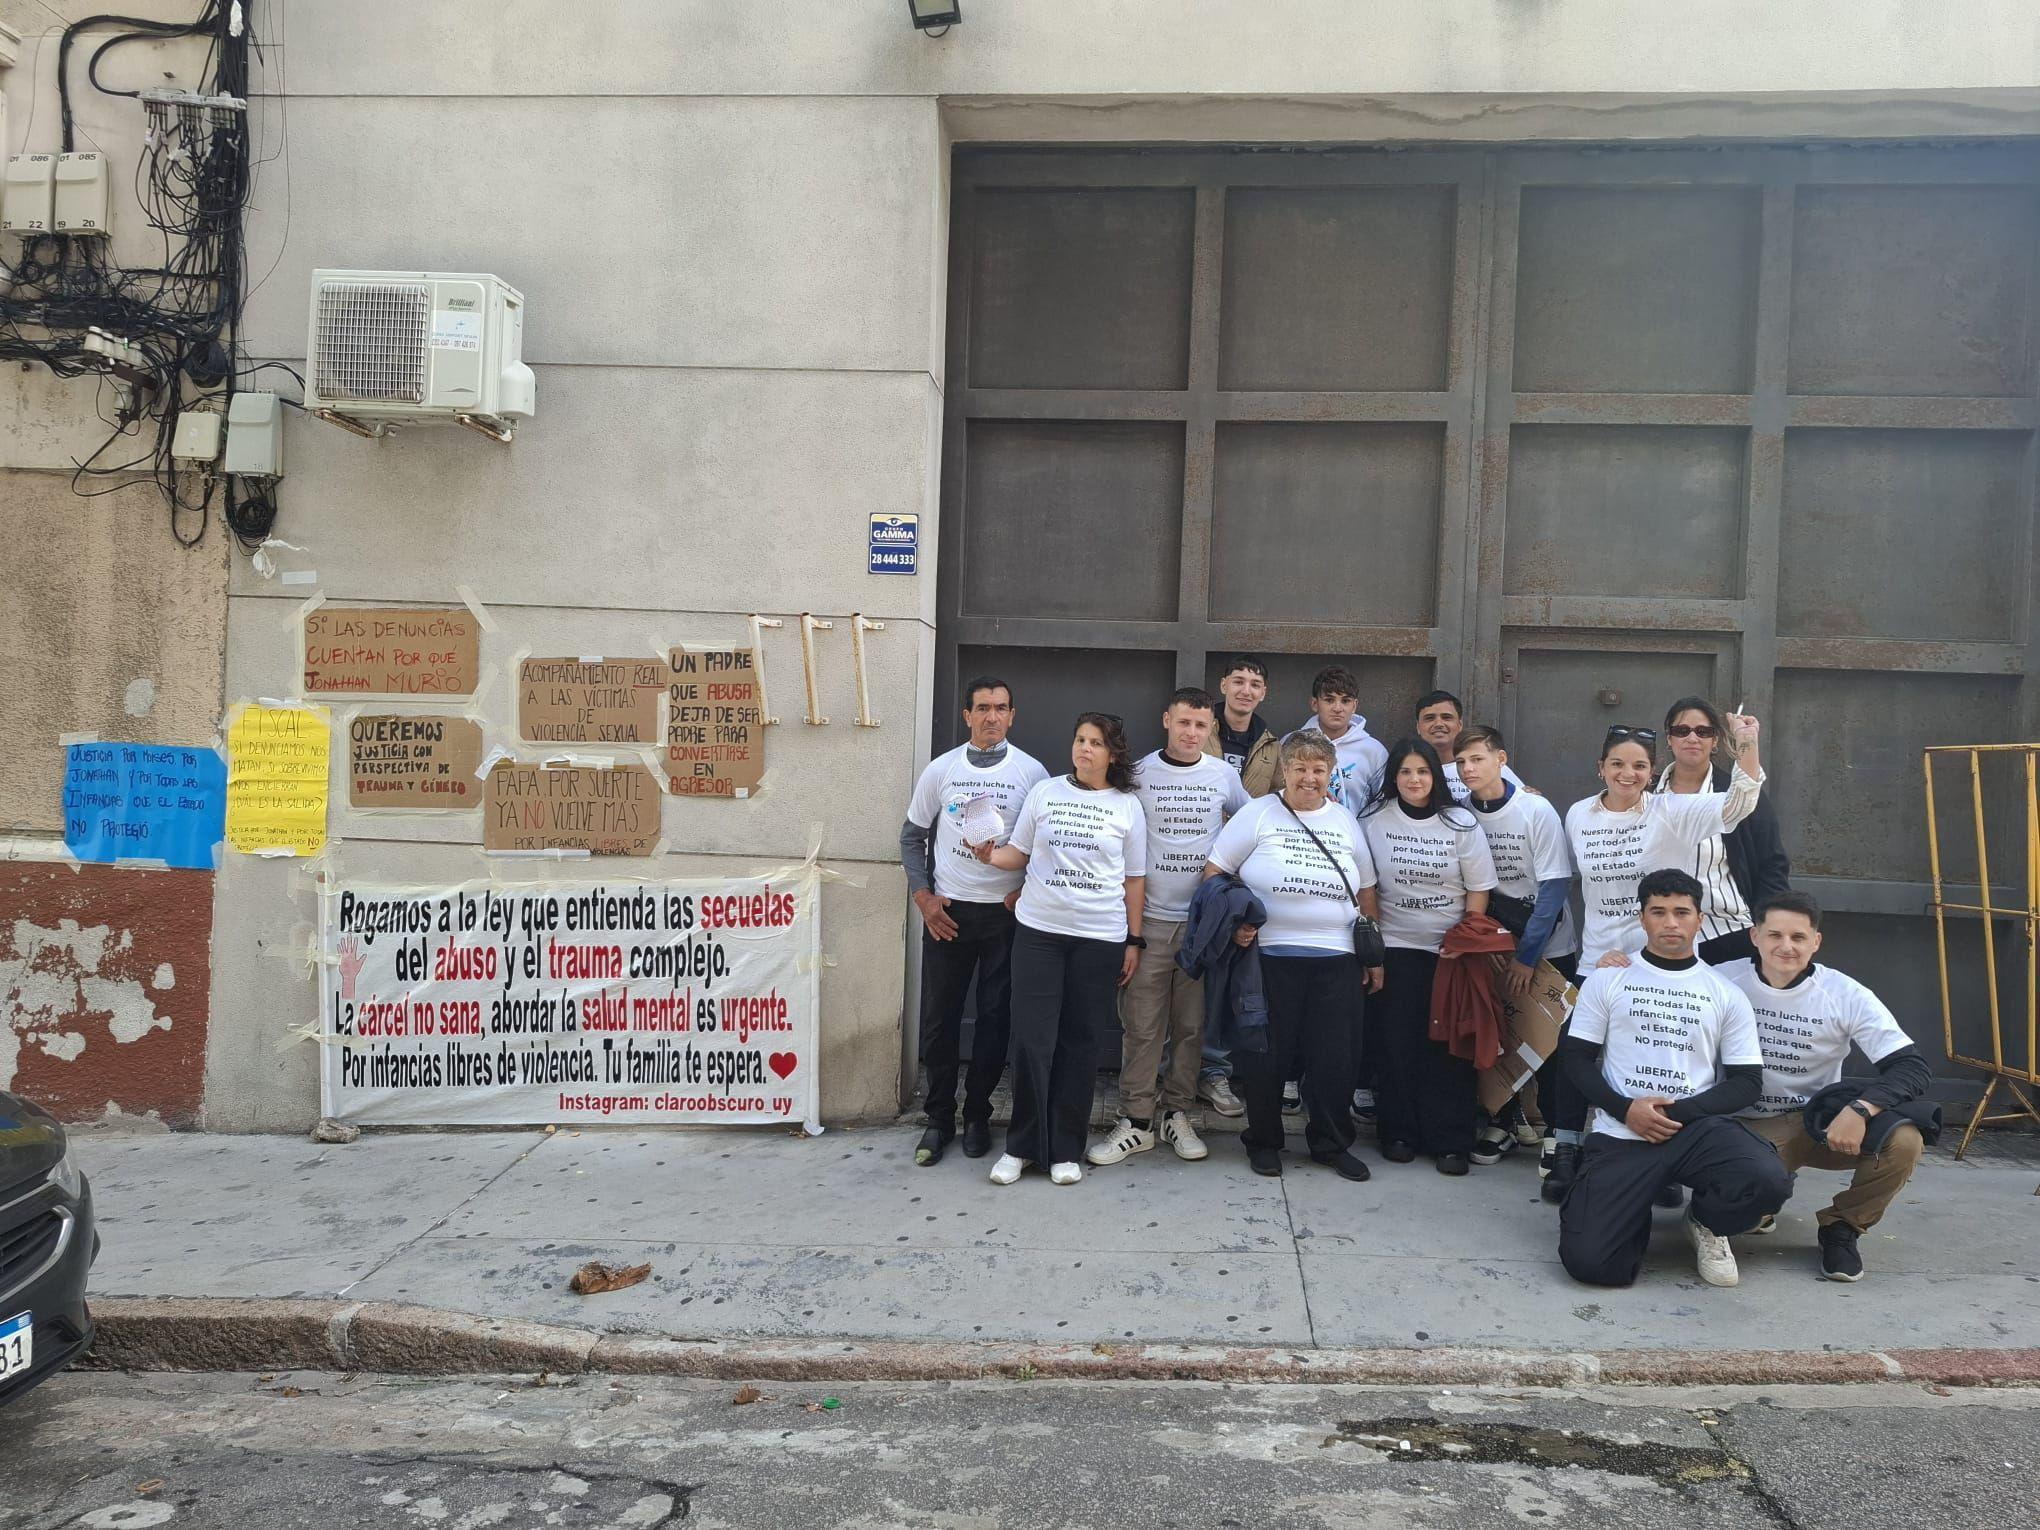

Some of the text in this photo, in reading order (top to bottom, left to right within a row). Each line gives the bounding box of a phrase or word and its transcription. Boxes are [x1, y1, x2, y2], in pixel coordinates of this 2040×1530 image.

[83, 220, 95, 228] 20
[873, 530, 914, 539] GAMMA
[872, 554, 914, 564] 28 444 333
[335, 621, 366, 637] LAS
[393, 650, 422, 666] POR
[672, 652, 752, 673] UN PADRE
[522, 663, 665, 686] ACOMPAÑAMIENTO REAL
[528, 686, 636, 708] A LAS VÍCTIMAS
[670, 683, 752, 702] QUE ABUSA
[578, 708, 594, 724] DE
[670, 705, 760, 724] DEJA DE SER
[352, 721, 444, 742] QUEREMOS
[532, 724, 640, 742] VIOLENCIA SEXUAL
[668, 726, 748, 744] PADRE PARA
[414, 746, 432, 758] CON
[670, 744, 750, 762] CONVERTIRSE
[438, 764, 450, 774] DE
[694, 763, 714, 778] EN
[406, 782, 414, 790] Y
[550, 770, 580, 798] POR
[588, 770, 644, 800] SUERTE
[671, 776, 733, 794] AGRESOR
[1150, 784, 1182, 792] Nuestra
[1184, 784, 1206, 792] lucha
[273, 797, 282, 808] LA
[496, 800, 518, 829] YA
[524, 800, 545, 830] NO
[551, 802, 598, 832] VUELVE
[1174, 816, 1202, 824] Estado
[72, 818, 86, 837] NO
[308, 836, 320, 846] NO
[515, 836, 536, 850] POR
[634, 838, 648, 848] DE
[1156, 864, 1178, 872] PARA
[340, 884, 794, 945] Rogamos a la ley que entienda las secuelas
[396, 932, 730, 990] del abuso y el trauma complejo.
[1624, 984, 1665, 995] Nuestra
[1668, 988, 1697, 999] lucha
[1632, 998, 1702, 1012] por todas las
[335, 986, 792, 1044] La cárcel no sana, abordar la salud mental es urgente.
[1629, 1008, 1700, 1026] infancias que
[1640, 1024, 1688, 1037] el Estado
[1635, 1036, 1650, 1044] NO
[342, 1038, 766, 1096] Por infancias libres de violencia. Tu familia te espera.
[1636, 1065, 1686, 1080] LIBERTAD
[1624, 1078, 1655, 1090] PARA
[560, 1093, 792, 1115] Instagram: claroobscuro_uy
